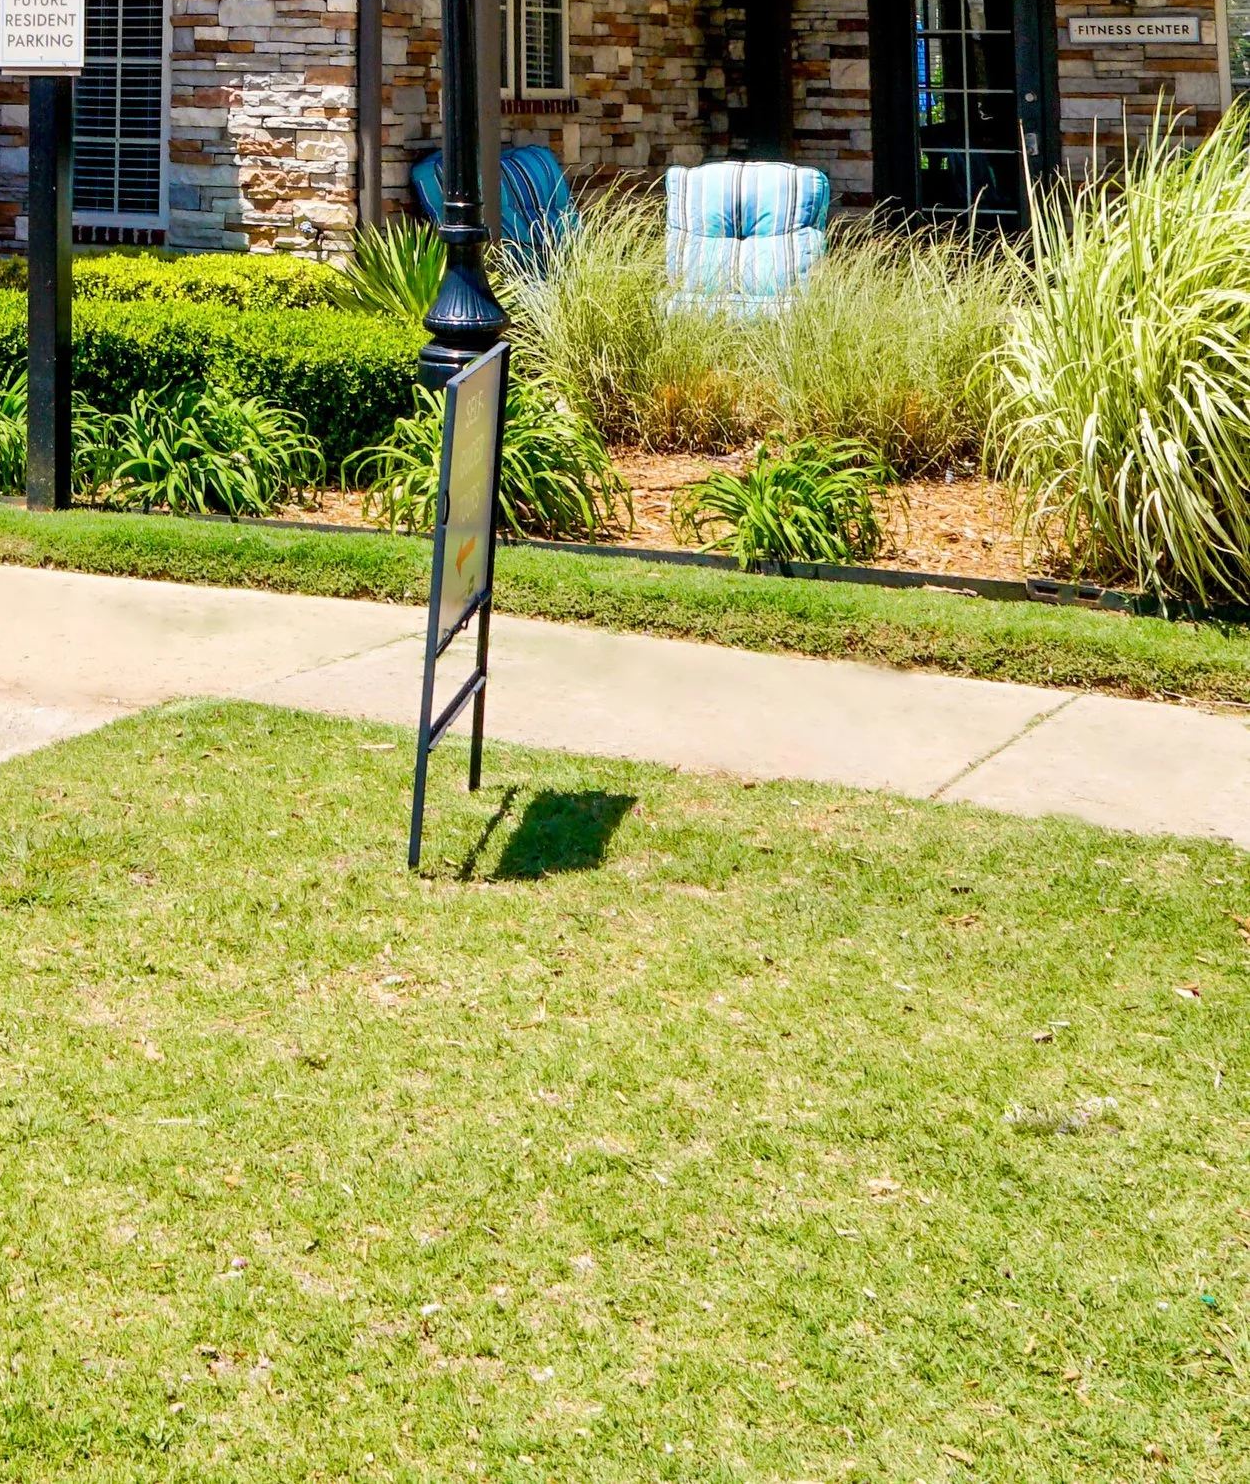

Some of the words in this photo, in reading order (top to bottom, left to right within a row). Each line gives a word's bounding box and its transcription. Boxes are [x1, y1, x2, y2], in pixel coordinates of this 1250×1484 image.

[5, 13, 77, 27] RESIDENT
[1078, 24, 1132, 35] FITNESS
[1137, 24, 1190, 35] CENTER
[7, 34, 74, 47] PARKING
